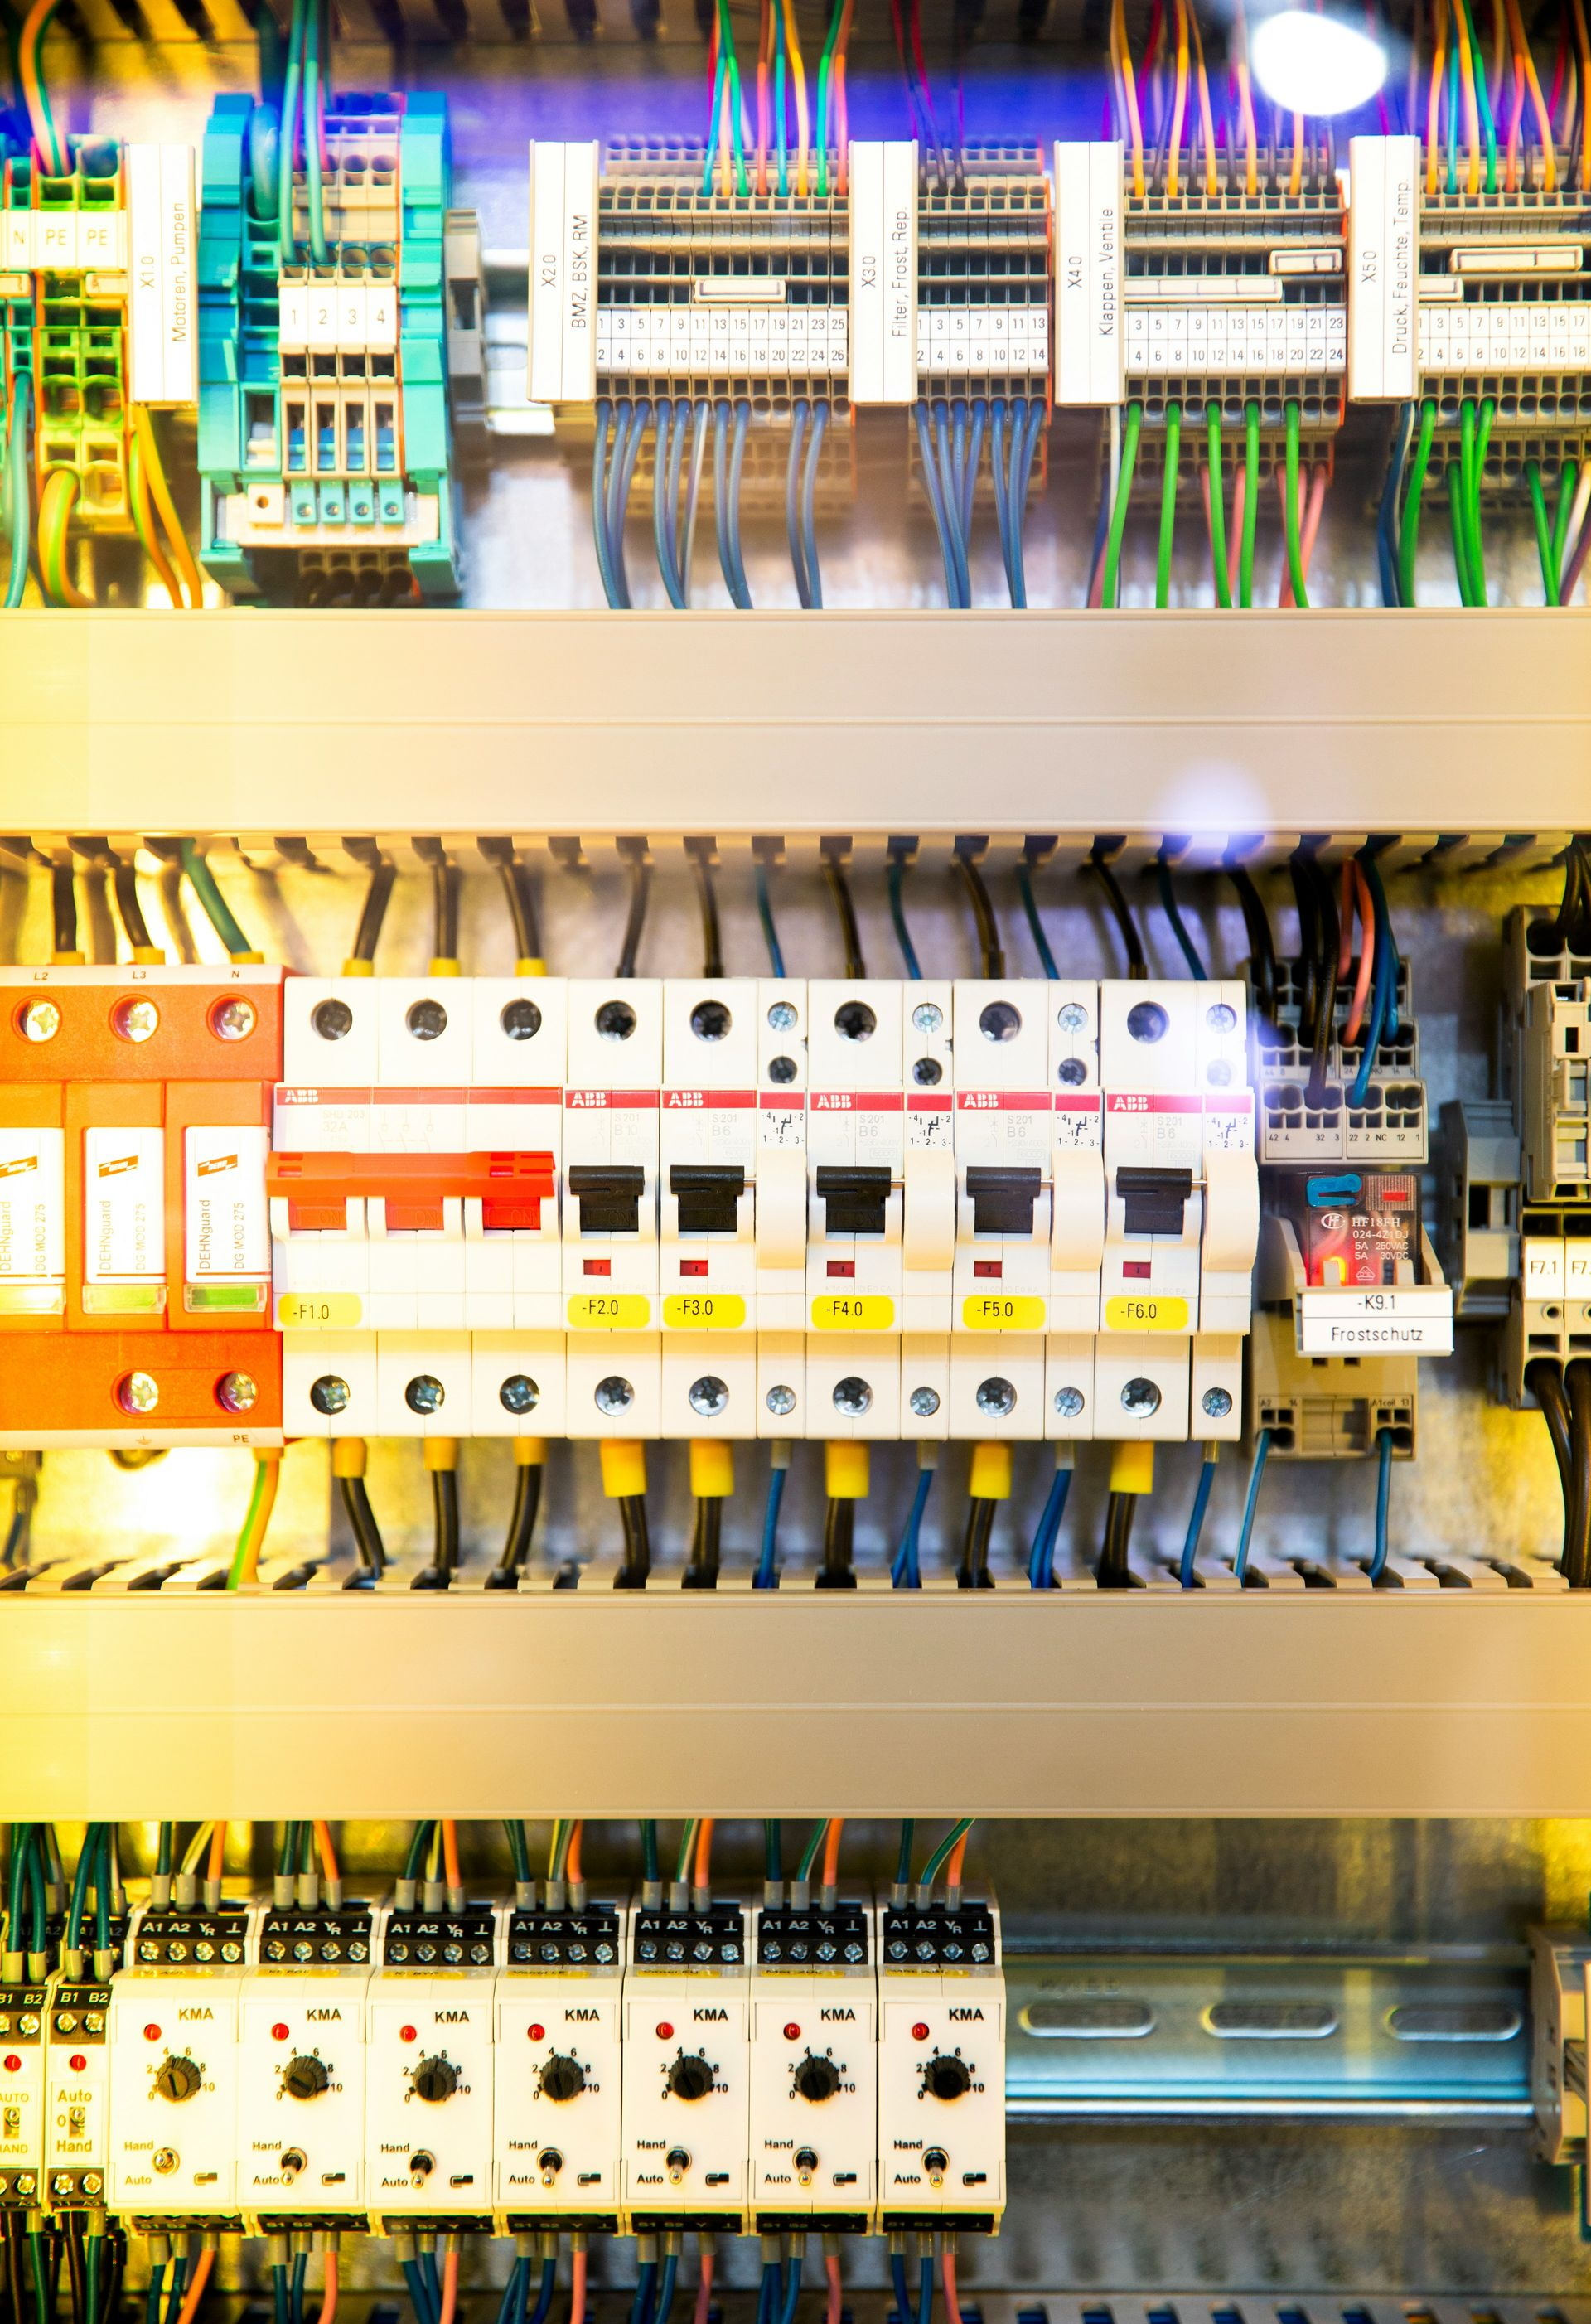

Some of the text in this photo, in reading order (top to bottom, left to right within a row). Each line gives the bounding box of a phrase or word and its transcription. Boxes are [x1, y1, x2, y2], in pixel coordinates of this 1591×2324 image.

[14, 229, 107, 245] N PE PE
[541, 255, 556, 287] X2.0
[572, 215, 588, 327] BMZ, BSK, RM
[1361, 252, 1376, 282] X5.0
[1393, 232, 1409, 298] Feuchte,
[140, 256, 154, 288] X1.0
[171, 203, 186, 341] Motoren, Pumpen
[862, 257, 876, 287] X3.0
[892, 207, 909, 336] Filter, Frost, Rep.
[1068, 257, 1081, 288] X4.0
[1099, 209, 1115, 335] Klappen, Ventile
[292, 308, 384, 325] 1 2 3 4
[600, 318, 844, 329] 1 3 5 7 9 11 13 15 17 19 21 23 25
[937, 319, 943, 330] 3
[957, 319, 963, 329] 5
[977, 319, 982, 329] 7
[996, 318, 1002, 329] 9
[1013, 318, 1023, 328] 11
[1033, 318, 1045, 328] 13
[1392, 304, 1408, 353] Druck,
[598, 349, 844, 361] 2 4 6 8 10 12 14 16 18 20 22 24 26
[937, 349, 1045, 361] 4 6 8 10 12 14
[34, 972, 48, 980] L2
[133, 971, 146, 979] L3
[284, 1090, 317, 1102] ABB
[572, 1093, 607, 1106] ABB
[669, 1092, 704, 1106] ABB
[817, 1095, 851, 1108] ABB
[964, 1094, 998, 1108] ABB
[1114, 1097, 1149, 1111] ABB
[1352, 1218, 1400, 1227] HF18FH
[35, 1204, 46, 1271] DG MOD 275
[99, 1200, 114, 1270] DEHNguard
[135, 1203, 146, 1270] DG MOD 275
[199, 1200, 212, 1269] DEHNguard
[234, 1203, 244, 1269] DG MOD 275
[1353, 1230, 1409, 1238] 024-4Z1DJ
[1531, 1261, 1556, 1273] F7.1
[582, 1298, 620, 1316] -F2.0
[675, 1298, 713, 1316] -F3.0
[1357, 1295, 1395, 1310] -K9.1
[291, 1302, 329, 1321] -F1.0
[825, 1300, 863, 1318] -F4.0
[975, 1300, 1014, 1318] -F5.0
[1120, 1302, 1158, 1319] -F6.0
[1332, 1326, 1423, 1341] Frostschutz
[233, 1435, 249, 1444] PE
[143, 1923, 190, 1932] A1 A2
[268, 1922, 316, 1931] A1 A2
[391, 1924, 438, 1933] A1 A2
[515, 1921, 562, 1930] A1 A2
[641, 1920, 687, 1929] A1 A2
[762, 1920, 809, 1929] A1 A2
[891, 1920, 936, 1929] A1 A2
[24, 1992, 42, 2007] B2
[60, 1993, 109, 2005] B1 B2
[179, 2008, 213, 2020] KMA
[307, 2009, 341, 2021] KMA
[435, 2011, 469, 2023] KMA
[565, 2009, 599, 2021] KMA
[694, 2009, 728, 2021] KMA
[821, 2009, 855, 2021] KMA
[949, 2009, 984, 2021] KMA
[57, 2089, 92, 2103] Auto
[56, 2140, 92, 2152] Hand
[124, 2141, 154, 2151] Hand
[253, 2141, 281, 2151] Hand
[381, 2143, 409, 2153] Hand
[509, 2141, 537, 2150] Hand
[637, 2140, 665, 2150] Hand
[765, 2140, 793, 2149] Hand
[894, 2140, 922, 2150] Hand
[125, 2176, 152, 2185] Auto
[253, 2176, 281, 2185] Auto
[382, 2178, 408, 2187] Auto
[509, 2175, 534, 2184] Auto
[637, 2175, 663, 2184] Auto
[765, 2174, 791, 2183] Auto
[894, 2175, 921, 2184] Auto
